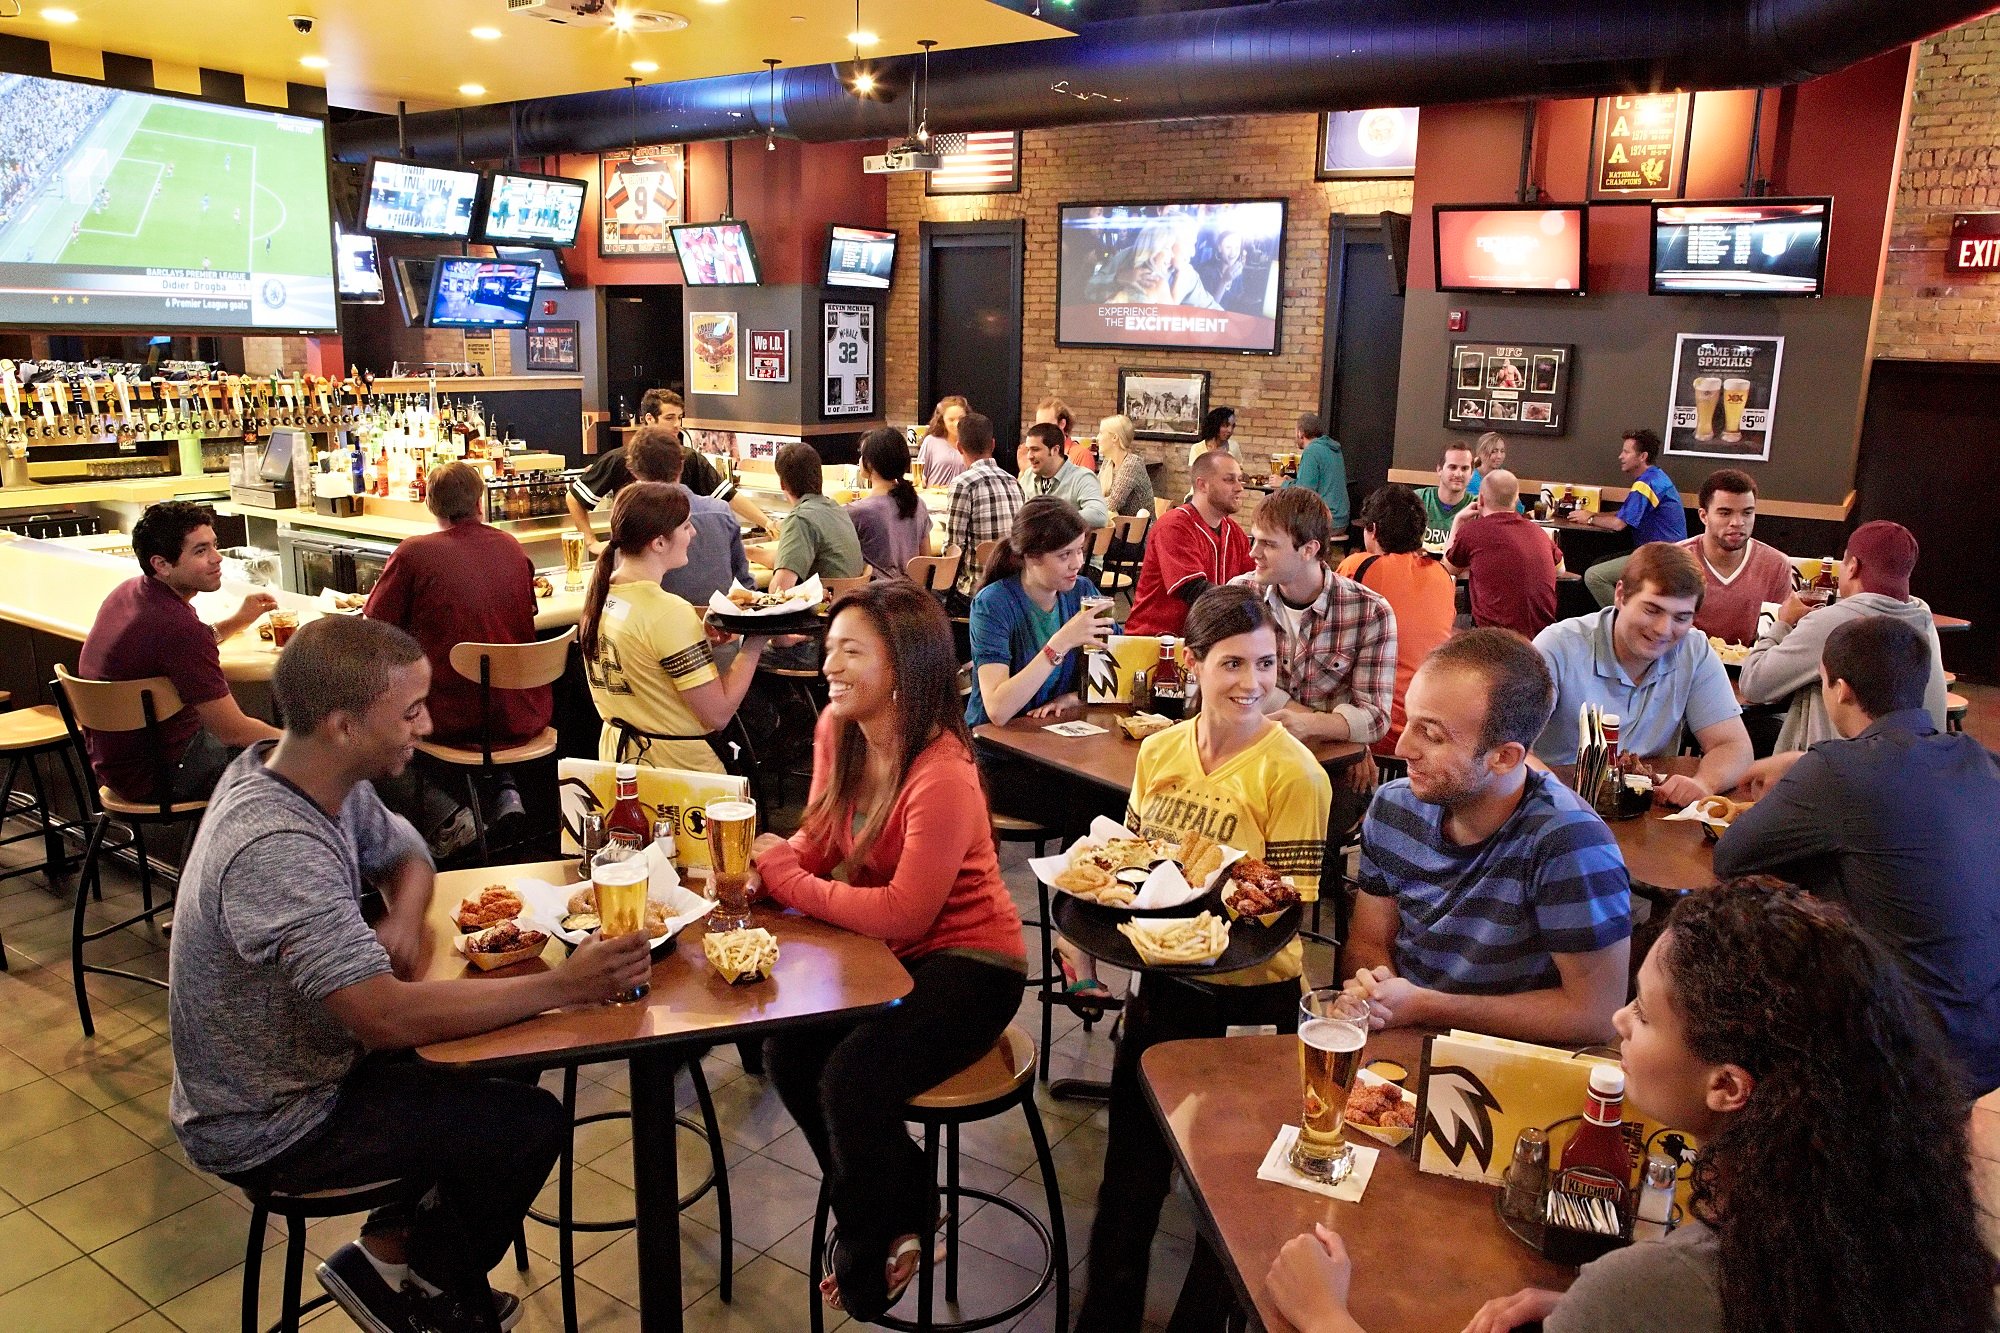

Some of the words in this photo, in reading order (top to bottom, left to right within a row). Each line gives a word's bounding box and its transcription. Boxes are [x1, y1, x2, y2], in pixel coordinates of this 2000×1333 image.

[1630, 145, 1647, 156] 1974
[1605, 178, 1642, 186] CHAMPIONS
[634, 186, 648, 220] 9
[1958, 240, 2000, 267] EXIT
[146, 268, 185, 277] BARCLAYS
[185, 269, 218, 279] PREMIER
[219, 271, 246, 280] LEAGUE
[162, 280, 189, 289] Didier
[194, 281, 226, 293] Drogba
[165, 298, 170, 307] 6
[171, 298, 201, 308] Premier
[203, 299, 228, 311] League
[229, 301, 248, 311] goals
[1098, 306, 1159, 316] EXPERIENCE
[1105, 317, 1124, 327] THE
[1125, 317, 1229, 333] EXCITEMENT
[754, 335, 767, 350] We
[769, 336, 782, 350] I.D.
[838, 342, 858, 363] 32
[1496, 347, 1522, 357] UFC
[1697, 346, 1730, 357] GAME
[1698, 357, 1752, 367] SPECIALS
[1568, 1180, 1615, 1199] KETCHUP
